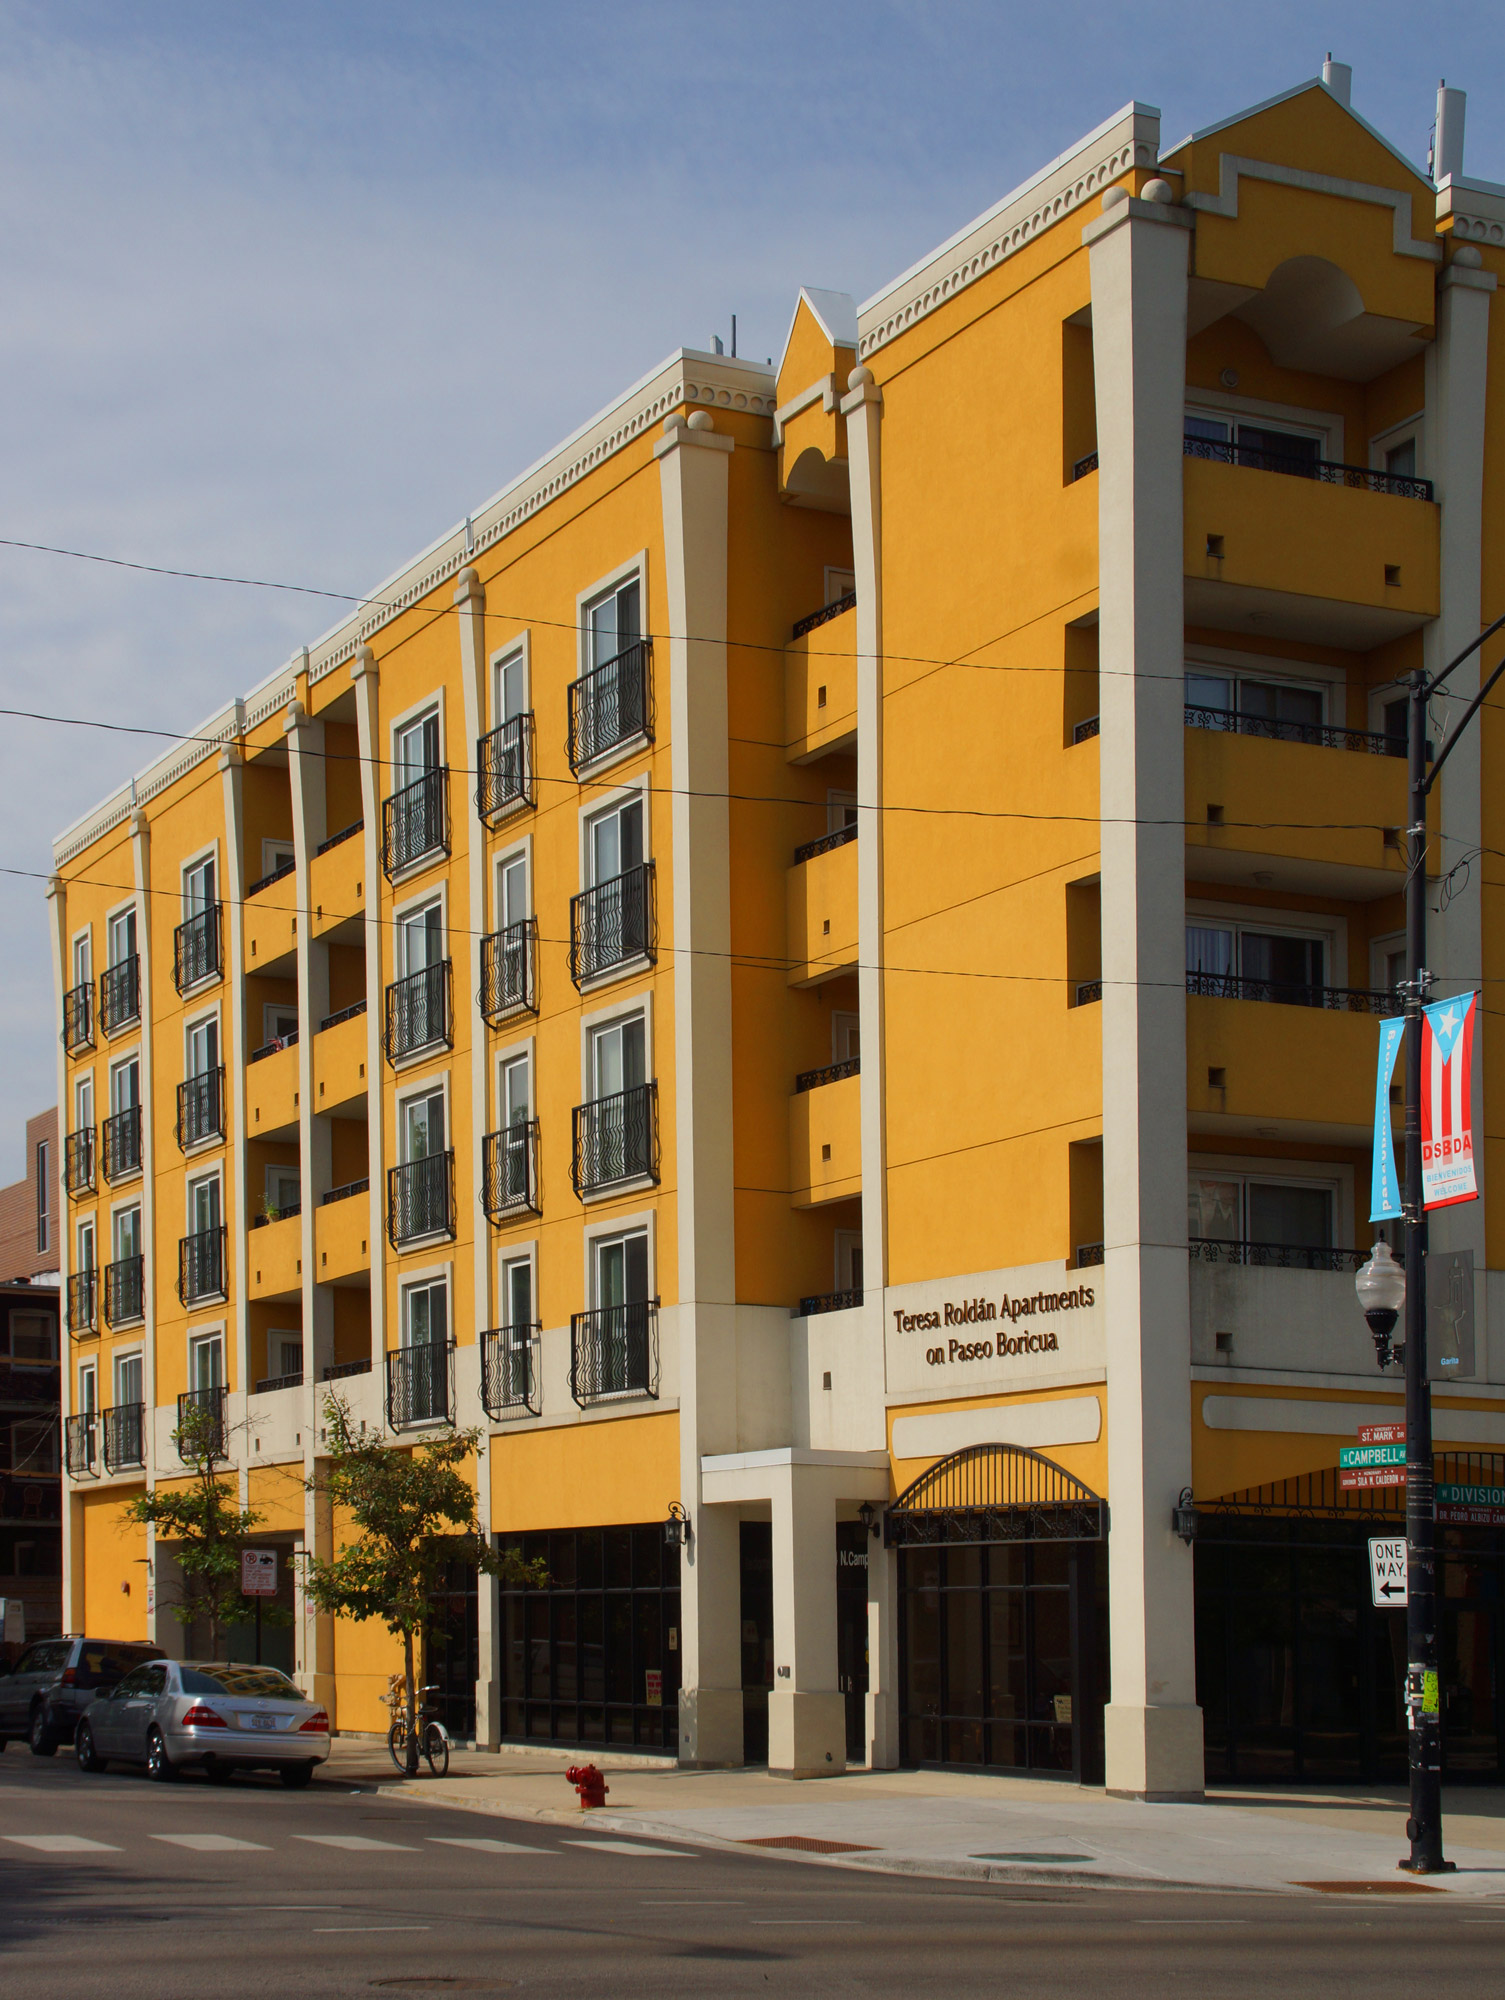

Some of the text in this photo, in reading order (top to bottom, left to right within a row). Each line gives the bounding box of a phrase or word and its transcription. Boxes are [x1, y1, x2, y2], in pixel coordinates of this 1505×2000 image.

[1423, 1134, 1472, 1161] DSBDA
[1426, 1164, 1472, 1183] BIENVENIDOS
[1434, 1183, 1467, 1197] WELCOME
[893, 1284, 1095, 1333] Teresa Roldán Apartments
[926, 1330, 1059, 1365] on Paseo Boricua
[1362, 1432, 1372, 1442] ST.
[1373, 1431, 1394, 1441] MARK
[1343, 1454, 1348, 1462] N
[1348, 1448, 1399, 1465] CAMPBELL
[1375, 1474, 1399, 1485] CALDERON
[1441, 1489, 1448, 1498] W
[1439, 1510, 1449, 1520] DR.
[1450, 1511, 1469, 1521] PEDRO
[1375, 1544, 1403, 1559] ONE
[1375, 1562, 1405, 1577] WAY
